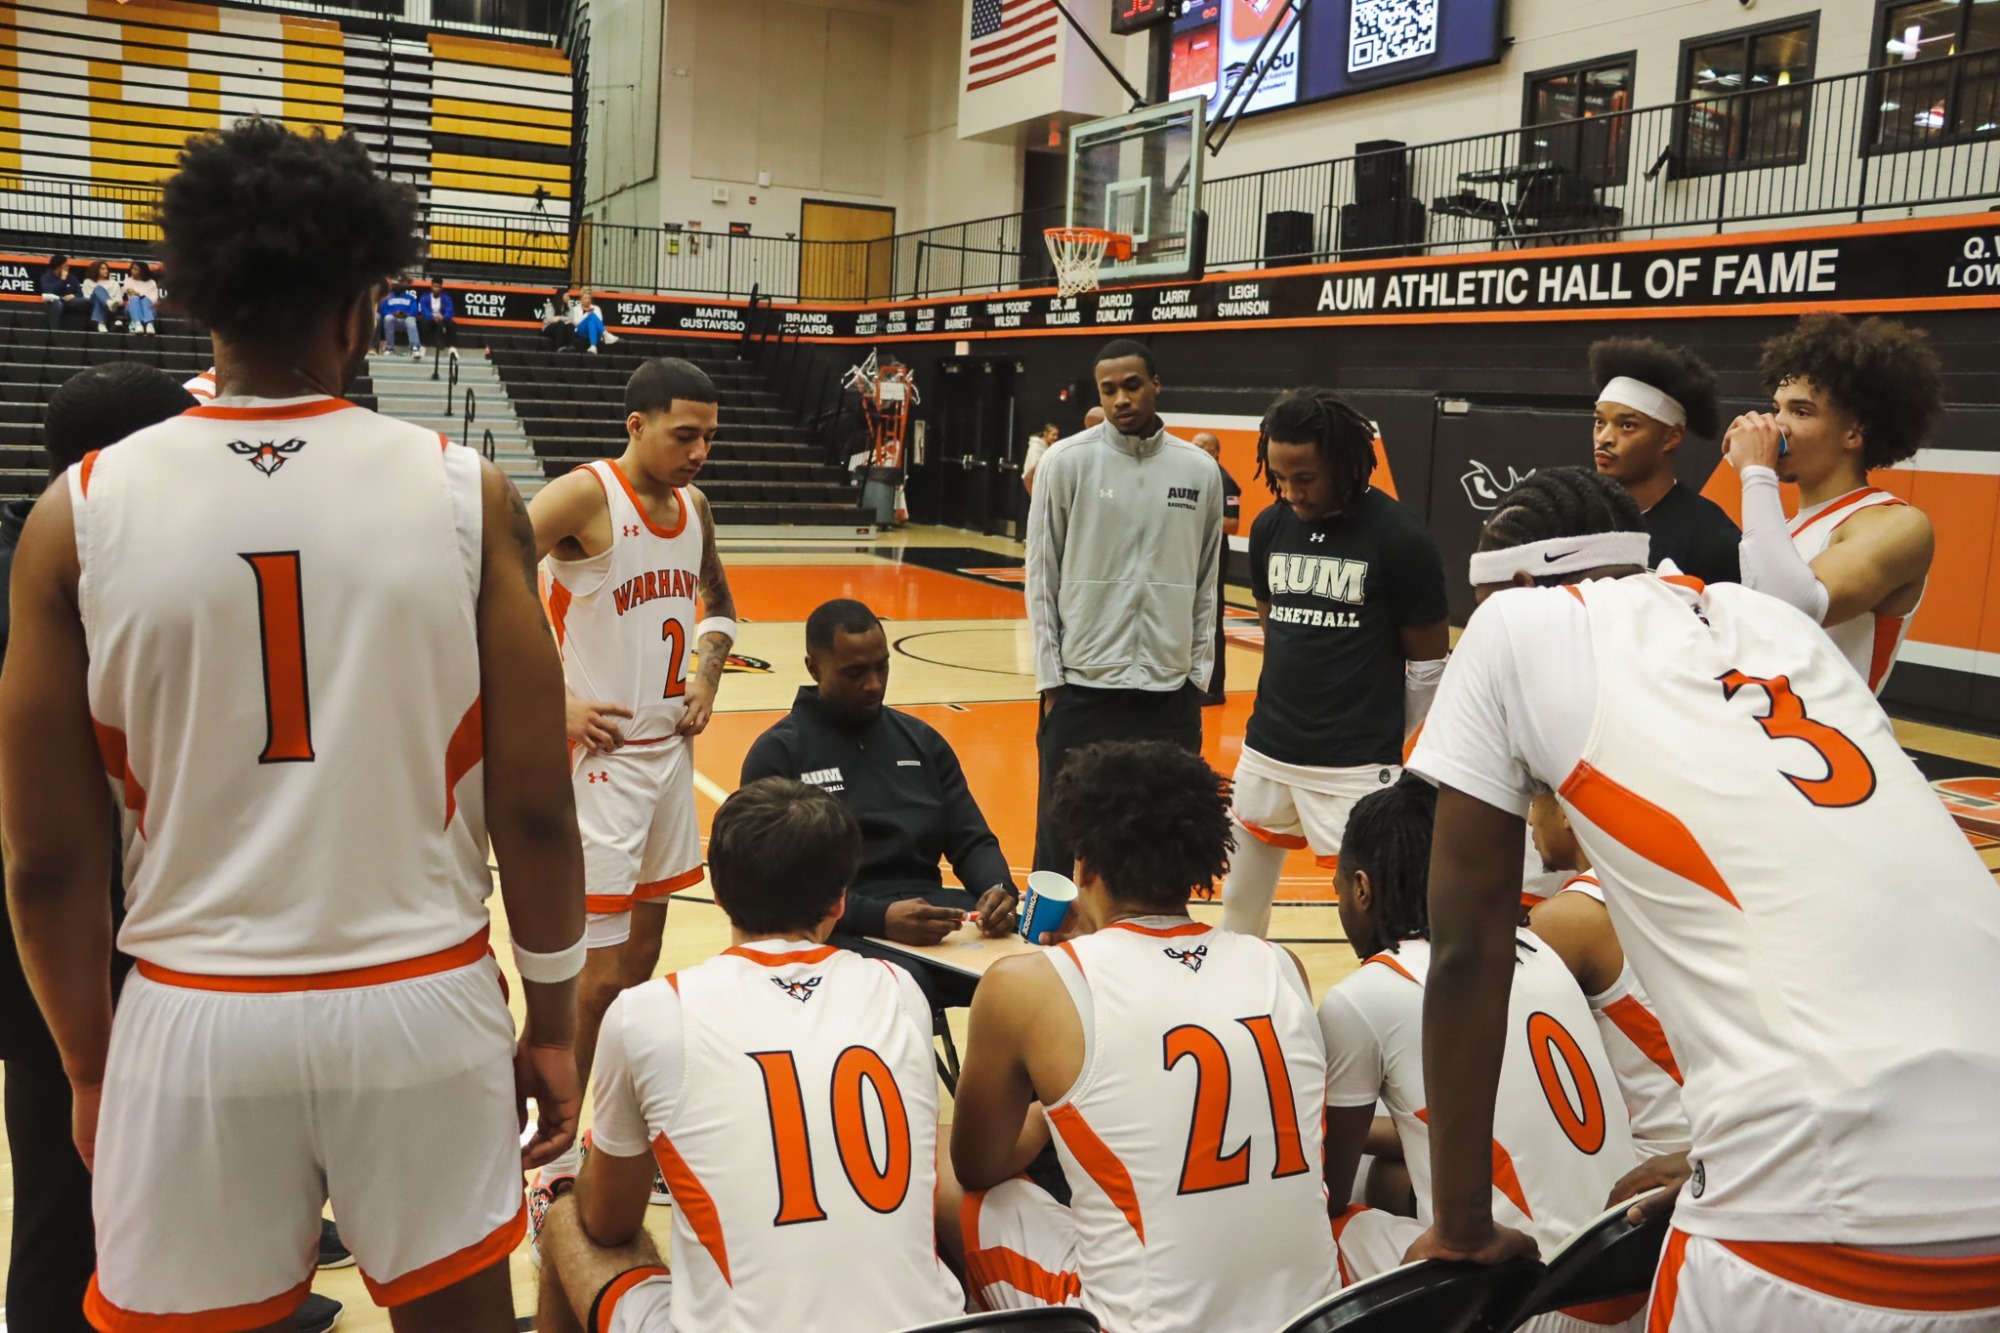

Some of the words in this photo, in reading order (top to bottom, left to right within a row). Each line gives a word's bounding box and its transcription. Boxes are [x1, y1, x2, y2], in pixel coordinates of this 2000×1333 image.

[0, 265, 29, 278] ILIA
[0, 279, 34, 292] APIE
[1317, 277, 1375, 311] AUM
[1382, 267, 1529, 309] ATHLETIC
[1537, 262, 1633, 303] HALL
[1644, 257, 1701, 299] OF
[1712, 249, 1839, 296] FAME
[465, 293, 506, 305] COLBY
[1160, 290, 1190, 304] LARRY
[1229, 284, 1259, 300] LEIGH
[1050, 299, 1062, 311] DR.
[1064, 298, 1077, 310] JIM
[1099, 294, 1133, 308] DAROLD
[465, 305, 505, 317] TILLEY
[617, 303, 655, 314] HEATH
[696, 308, 738, 319] MARTIN
[950, 306, 968, 317] KATIE
[1152, 305, 1197, 320] CHAPMAN
[1217, 301, 1269, 317] SWANSON
[621, 315, 651, 325] ZAPF
[786, 313, 827, 323] BRANDI
[994, 316, 1021, 327] WILSON
[1045, 312, 1080, 325] WILLIAMS
[1096, 309, 1134, 323] DUNLAVY
[680, 318, 745, 331] GUSTAVSSO
[945, 318, 972, 330] BARNETT
[1167, 487, 1200, 503] AUM
[1268, 552, 1369, 606] AUM
[1269, 604, 1360, 628] ASKETBALL
[237, 550, 315, 764] 1
[661, 618, 687, 699] 2
[1714, 668, 1876, 808] 3
[800, 767, 844, 785] AUM
[1527, 1011, 1606, 1156] 0
[1162, 1014, 1309, 1196] 21
[746, 1045, 912, 1227] 10
